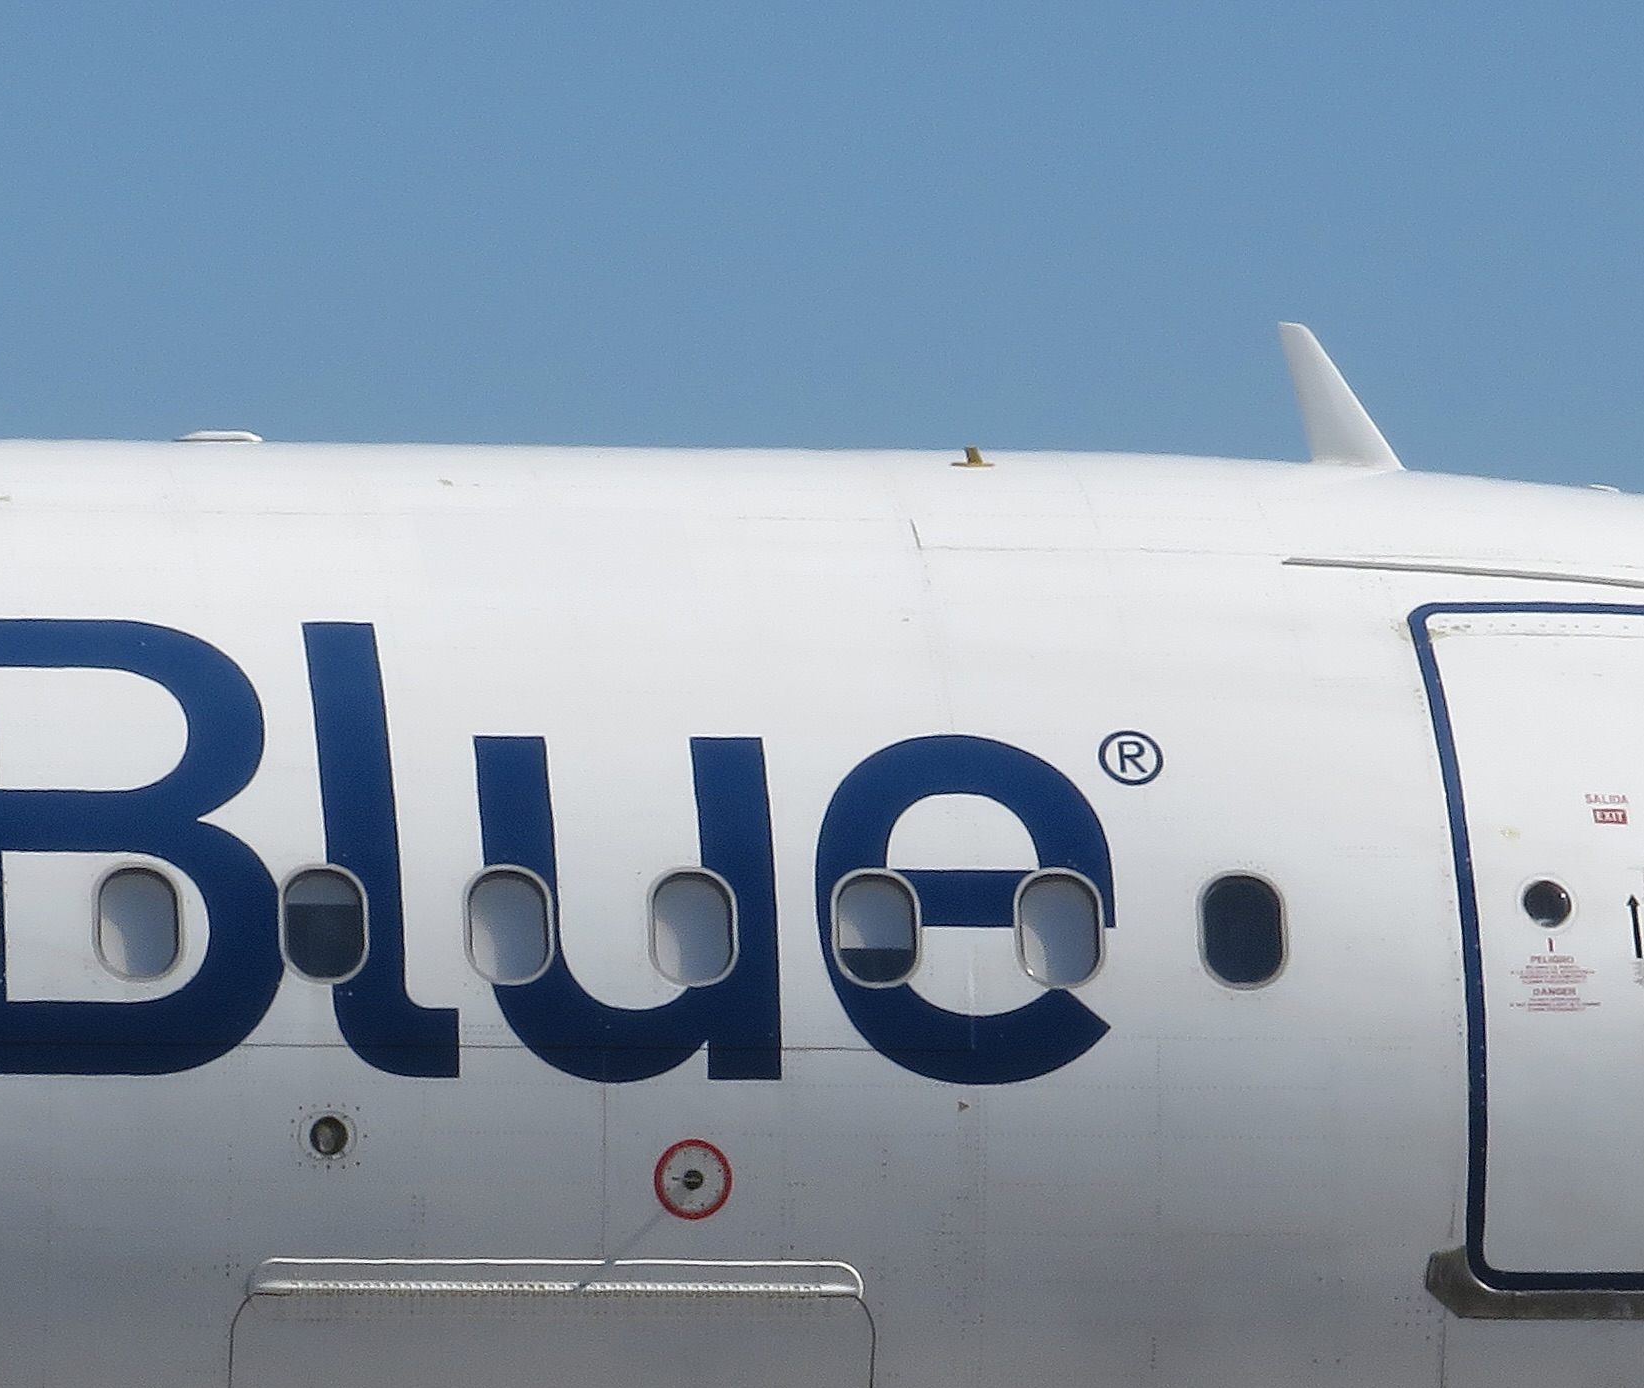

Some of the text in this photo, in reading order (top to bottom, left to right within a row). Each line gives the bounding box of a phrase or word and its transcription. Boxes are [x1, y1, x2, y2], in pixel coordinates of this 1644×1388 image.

[1585, 793, 1630, 805] SALIDA
[1594, 810, 1626, 823] EXIT
[1532, 987, 1577, 996] DANGER
